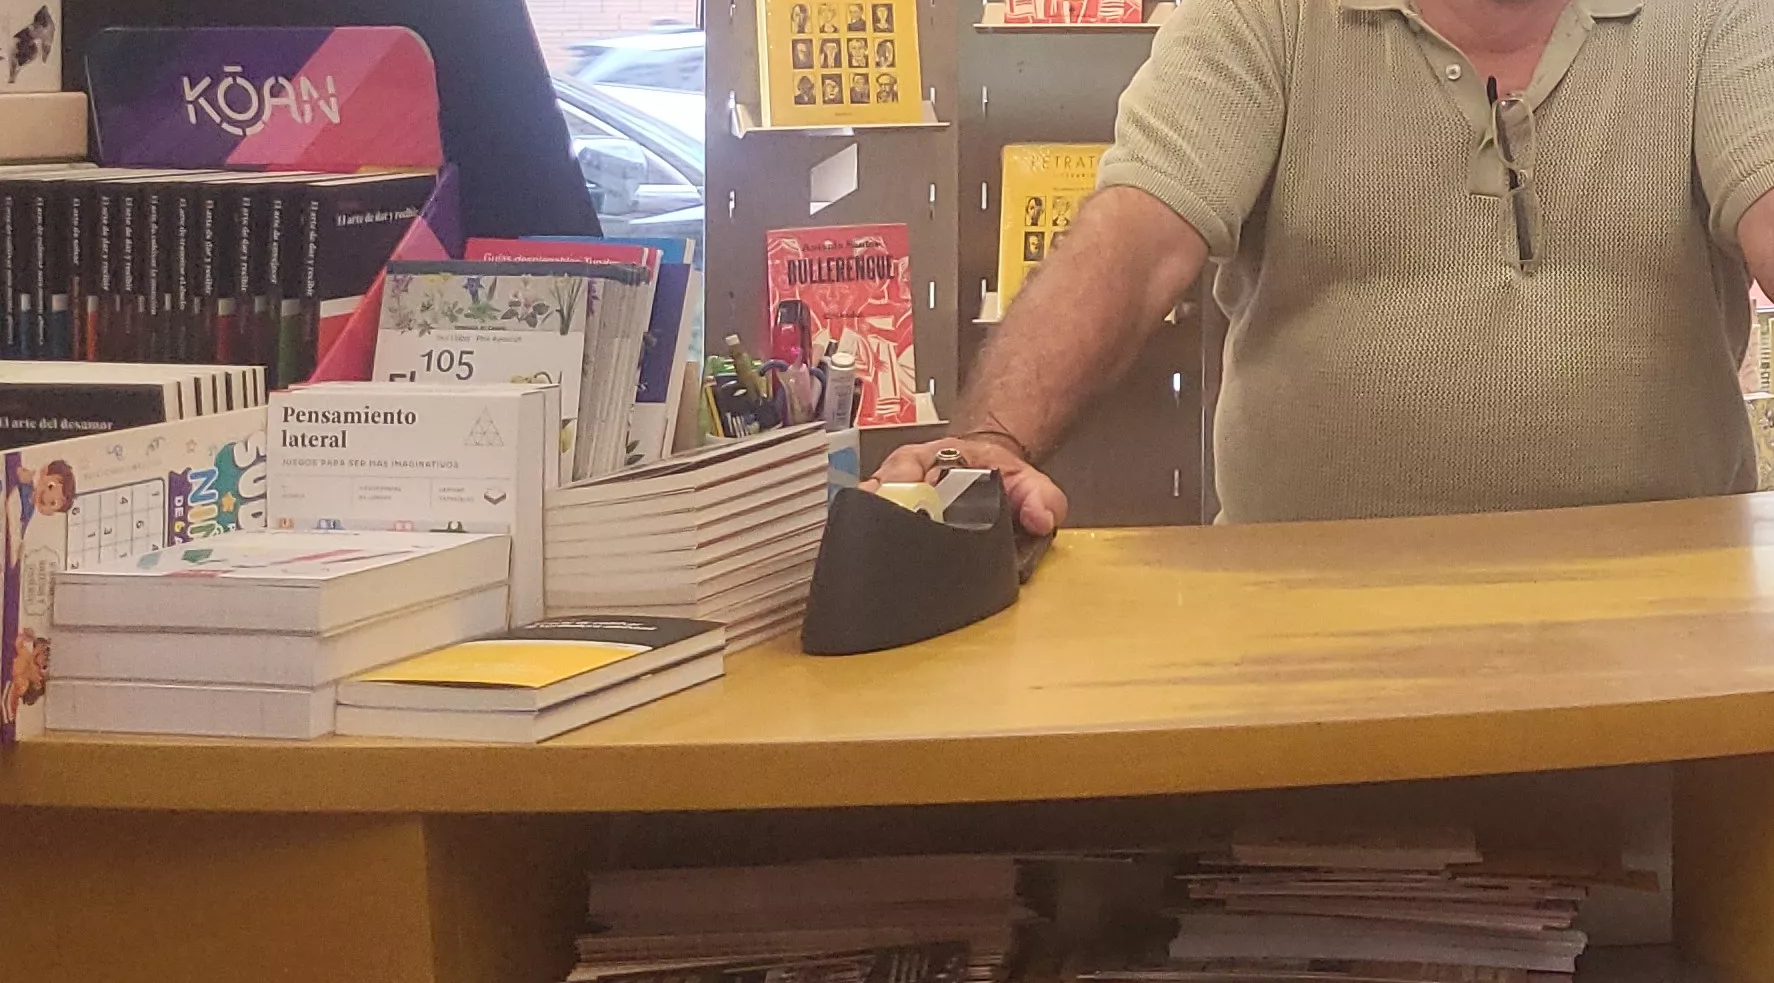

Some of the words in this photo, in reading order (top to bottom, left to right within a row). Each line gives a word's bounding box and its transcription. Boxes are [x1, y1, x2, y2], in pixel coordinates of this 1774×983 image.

[1031, 155, 1096, 170] RETRAT
[310, 212, 318, 228] arte
[337, 214, 346, 226] El
[347, 214, 362, 225] arte
[365, 213, 376, 223] de
[376, 212, 388, 223] dar
[395, 207, 419, 219] recibi
[308, 243, 317, 257] dar
[787, 254, 895, 286] BULLERENGUE
[306, 267, 315, 297] recibir
[420, 348, 475, 380] 105
[11, 418, 36, 430] arte
[39, 417, 58, 430] del
[60, 418, 114, 430] desamor
[282, 405, 417, 426] Pensamiento
[282, 429, 347, 448] lateral
[282, 459, 318, 467] JUEGOS
[320, 459, 345, 467] PARA
[348, 459, 366, 468] SER
[391, 460, 459, 469] IMAGINATIVOS
[233, 430, 268, 530] SUD
[174, 495, 185, 517] DE
